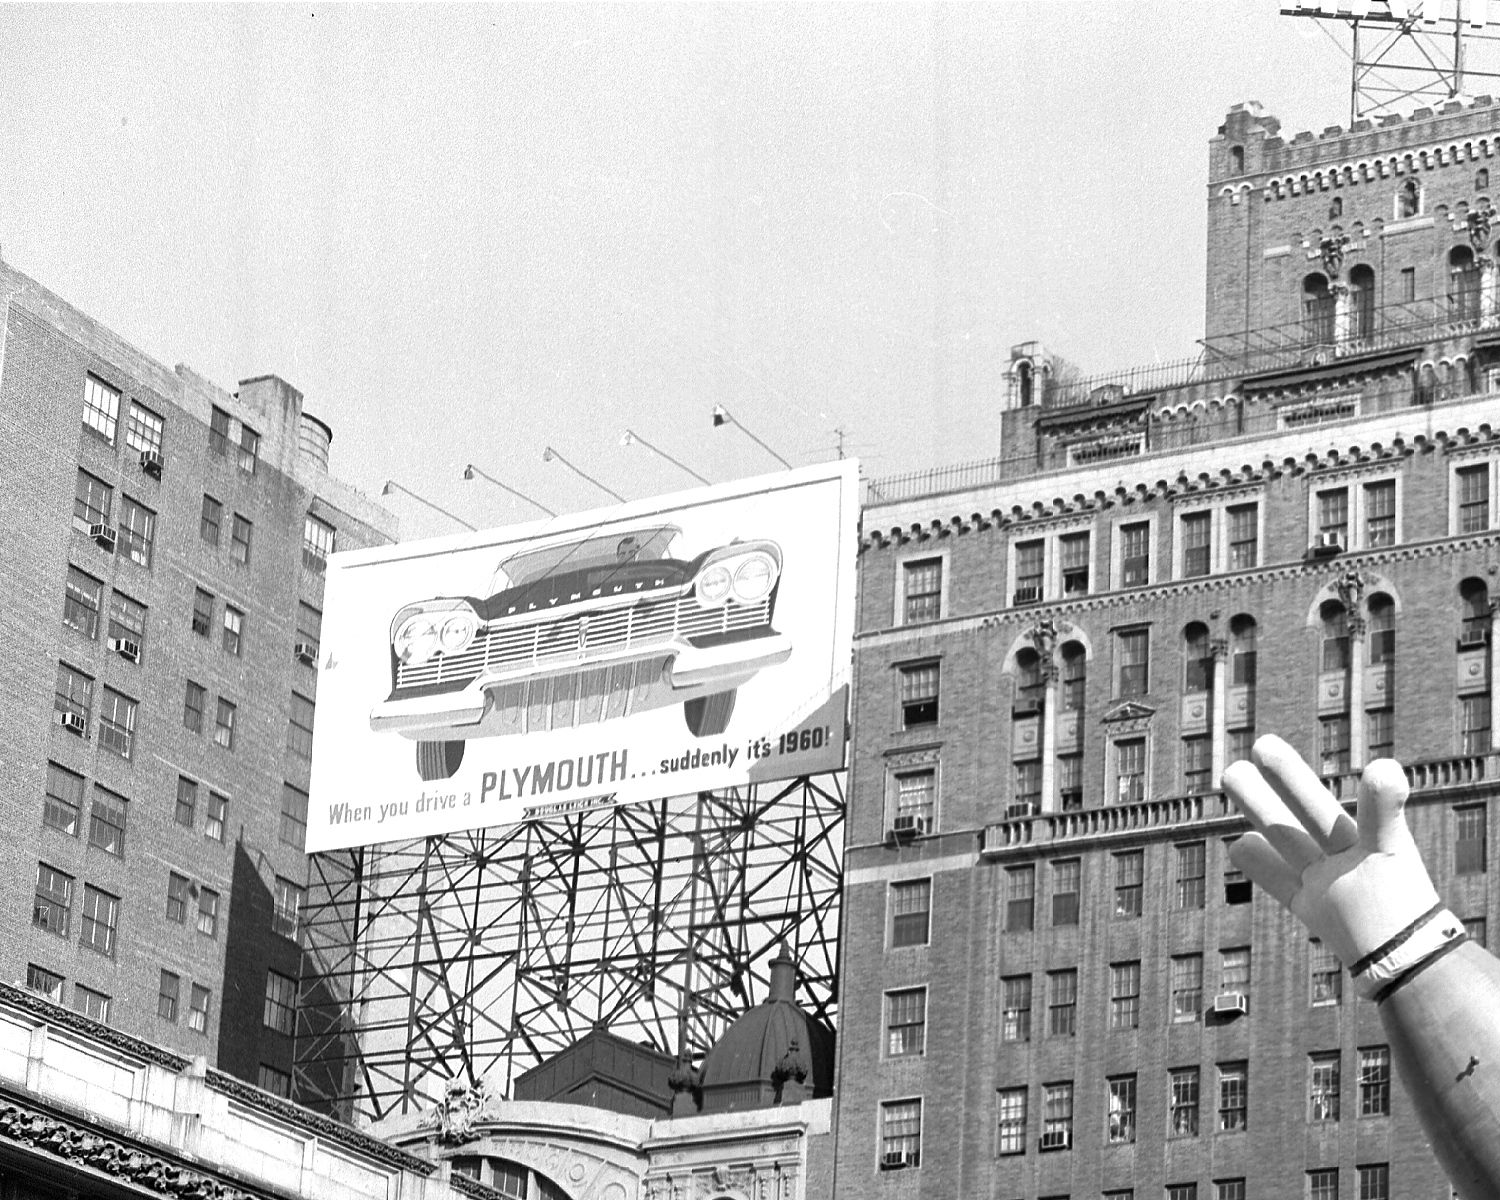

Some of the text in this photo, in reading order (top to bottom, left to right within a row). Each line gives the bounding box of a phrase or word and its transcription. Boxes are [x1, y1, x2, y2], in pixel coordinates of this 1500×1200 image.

[329, 801, 372, 825] When
[377, 801, 409, 823] you
[415, 789, 457, 813] drive
[462, 791, 471, 806] a
[660, 743, 740, 774] suddenly
[747, 736, 771, 761] it's
[778, 725, 830, 756] 1960!
